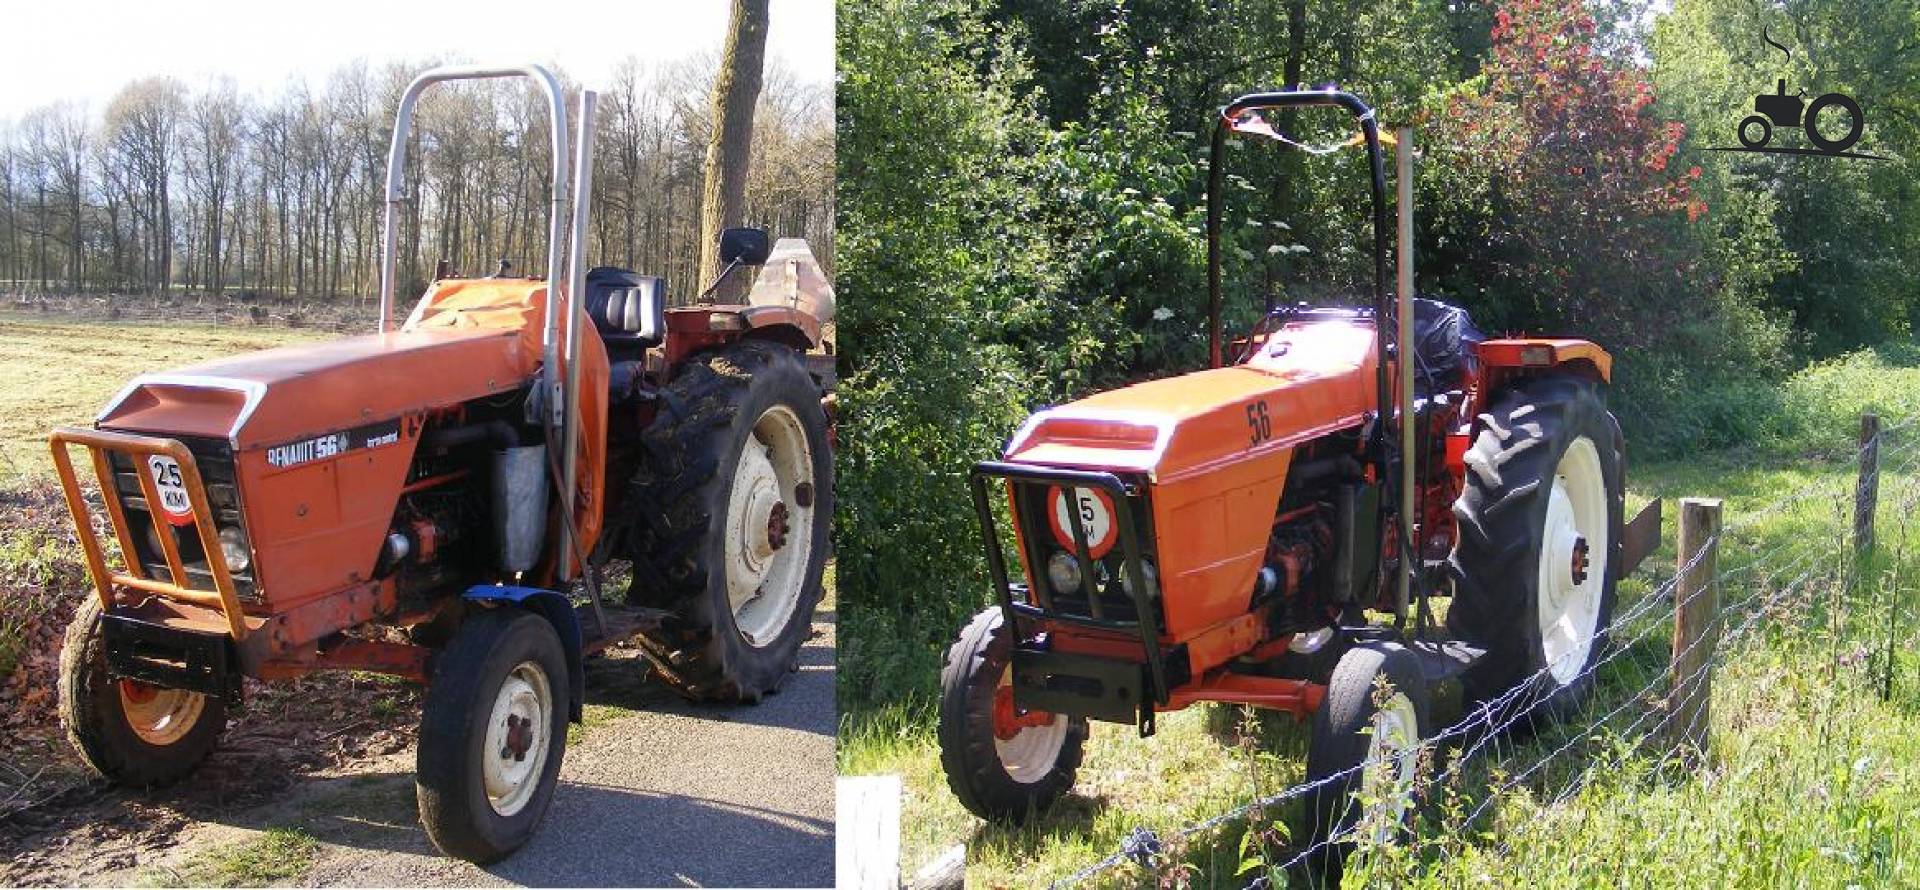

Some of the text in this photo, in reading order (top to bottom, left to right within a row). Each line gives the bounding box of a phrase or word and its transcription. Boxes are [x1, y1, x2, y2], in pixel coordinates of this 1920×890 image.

[1246, 400, 1271, 445] 56
[268, 440, 315, 468] RENAULT
[316, 434, 337, 459] 56
[154, 461, 182, 488] 25
[164, 490, 187, 507] KM
[1078, 497, 1095, 522] 5
